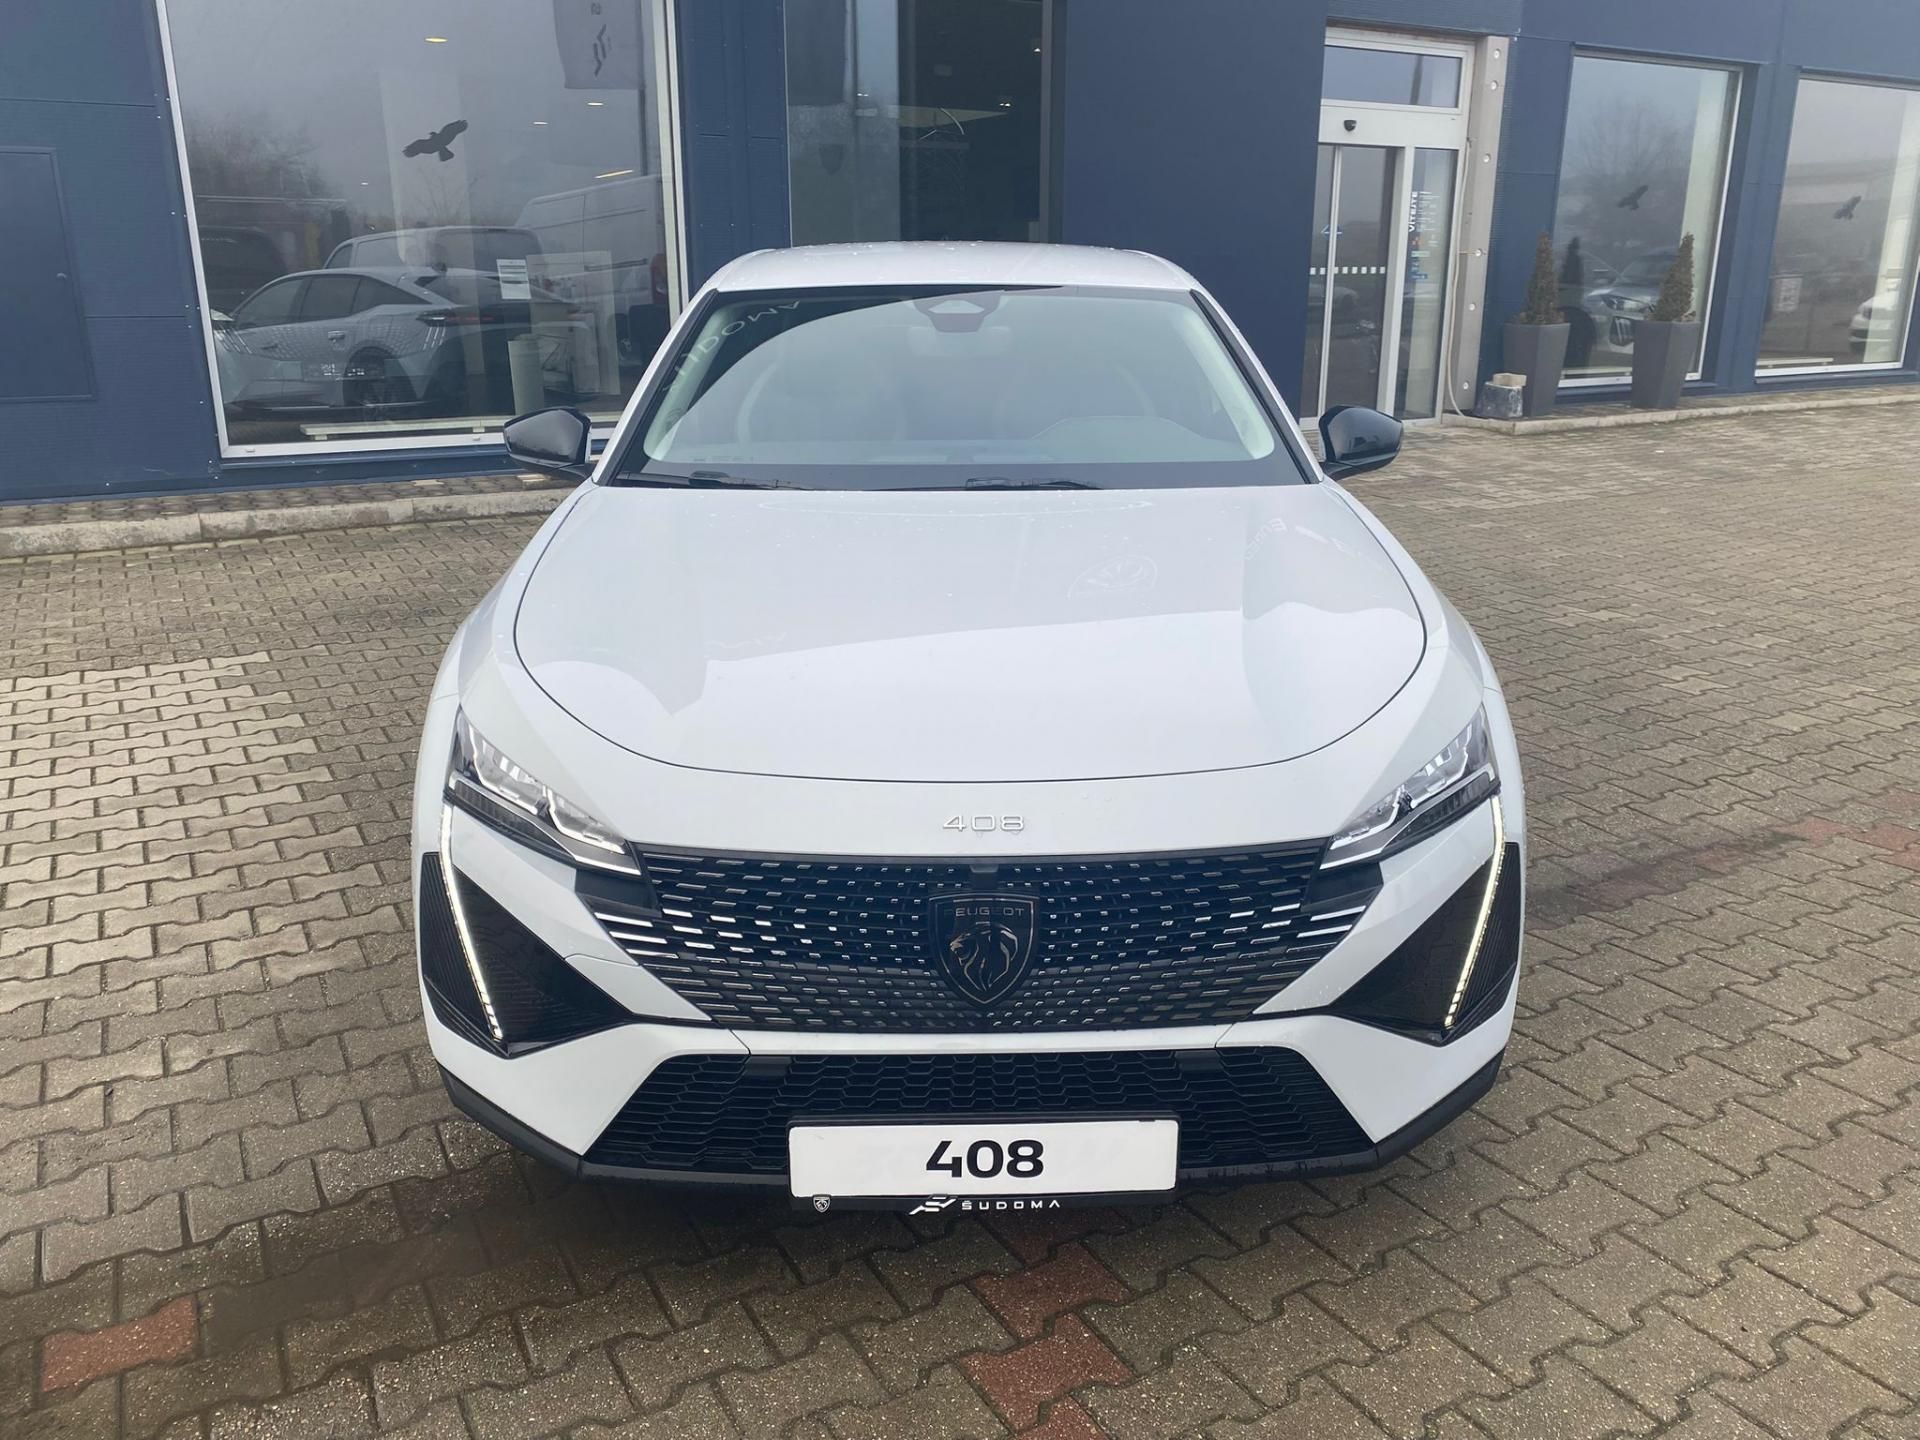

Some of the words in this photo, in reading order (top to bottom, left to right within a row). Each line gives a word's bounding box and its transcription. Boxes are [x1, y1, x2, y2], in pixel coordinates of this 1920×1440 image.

[943, 815, 1024, 832] 408
[944, 907, 1025, 917] EUGOT
[926, 1139, 1044, 1178] 408
